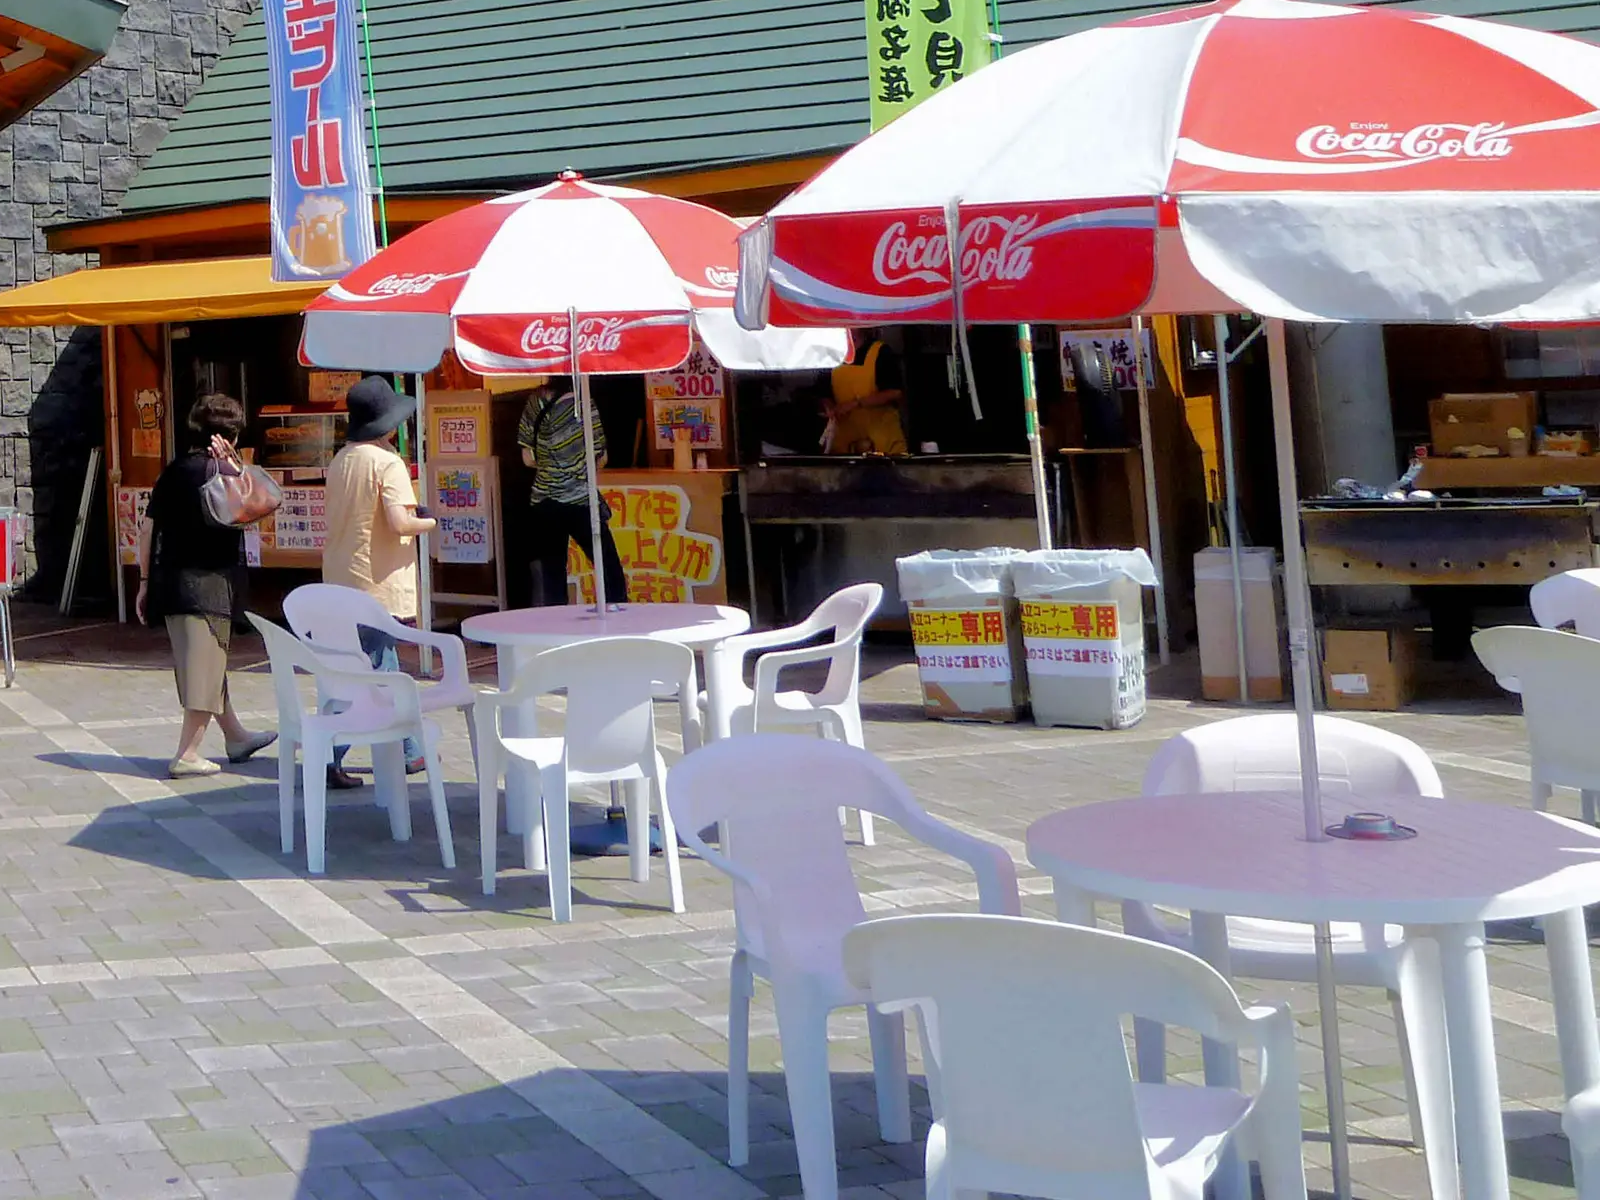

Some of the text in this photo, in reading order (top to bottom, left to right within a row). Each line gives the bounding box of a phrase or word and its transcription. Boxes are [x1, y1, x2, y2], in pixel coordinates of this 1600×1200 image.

[1296, 122, 1513, 159] Coca-Cola
[1350, 122, 1388, 130] Enjoy
[873, 213, 1038, 289] CocaCola
[521, 317, 624, 354] CocaCola
[441, 420, 475, 431] タコカラ
[437, 470, 482, 489] 生ビール
[959, 611, 1005, 644] 専用
[1070, 604, 1116, 638] 専用
